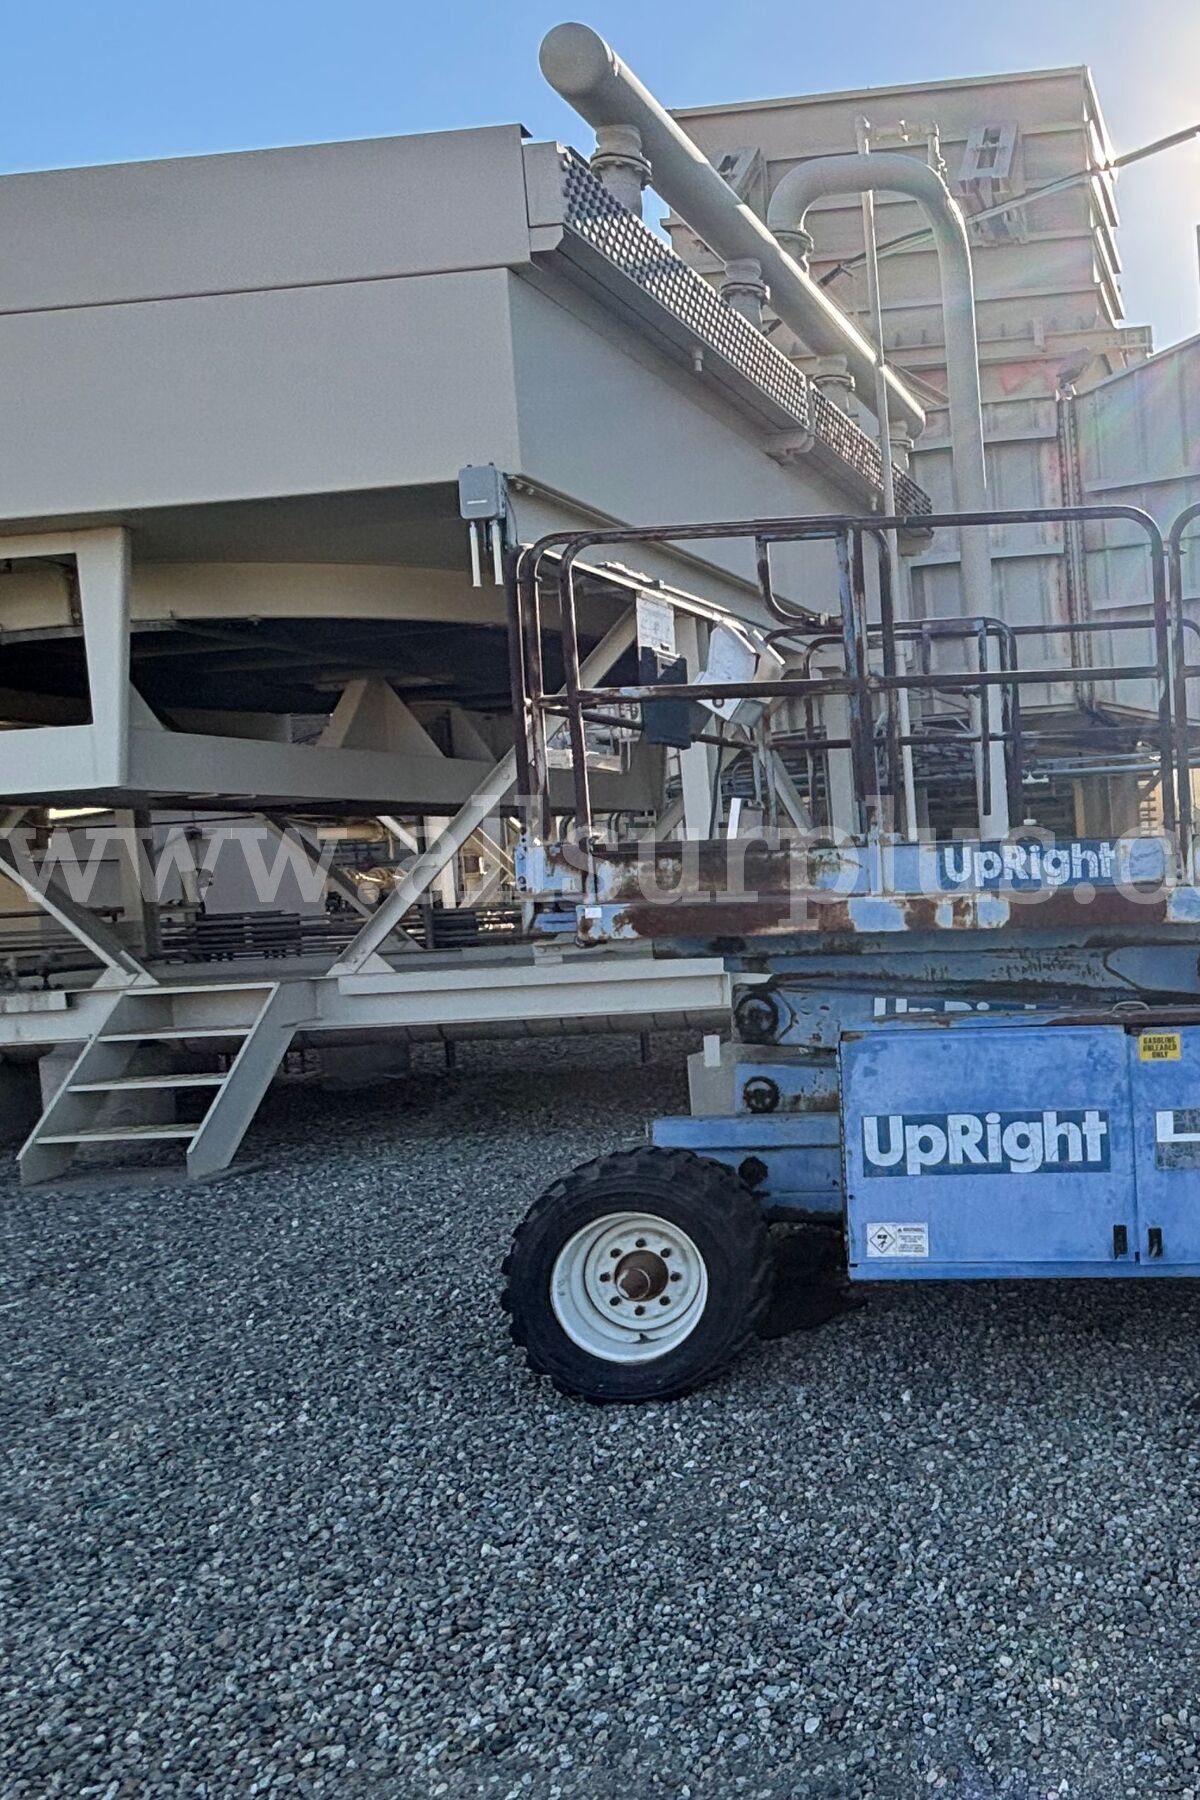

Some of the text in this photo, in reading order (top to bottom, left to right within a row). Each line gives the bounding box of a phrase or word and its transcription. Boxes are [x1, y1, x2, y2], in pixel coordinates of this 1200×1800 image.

[943, 841, 1116, 887] UpRight
[1143, 1036, 1176, 1045] GASOLINE
[1142, 1044, 1178, 1052] UNLEADED
[1151, 1051, 1169, 1059] ONLY
[862, 1110, 1108, 1176] UpRight
